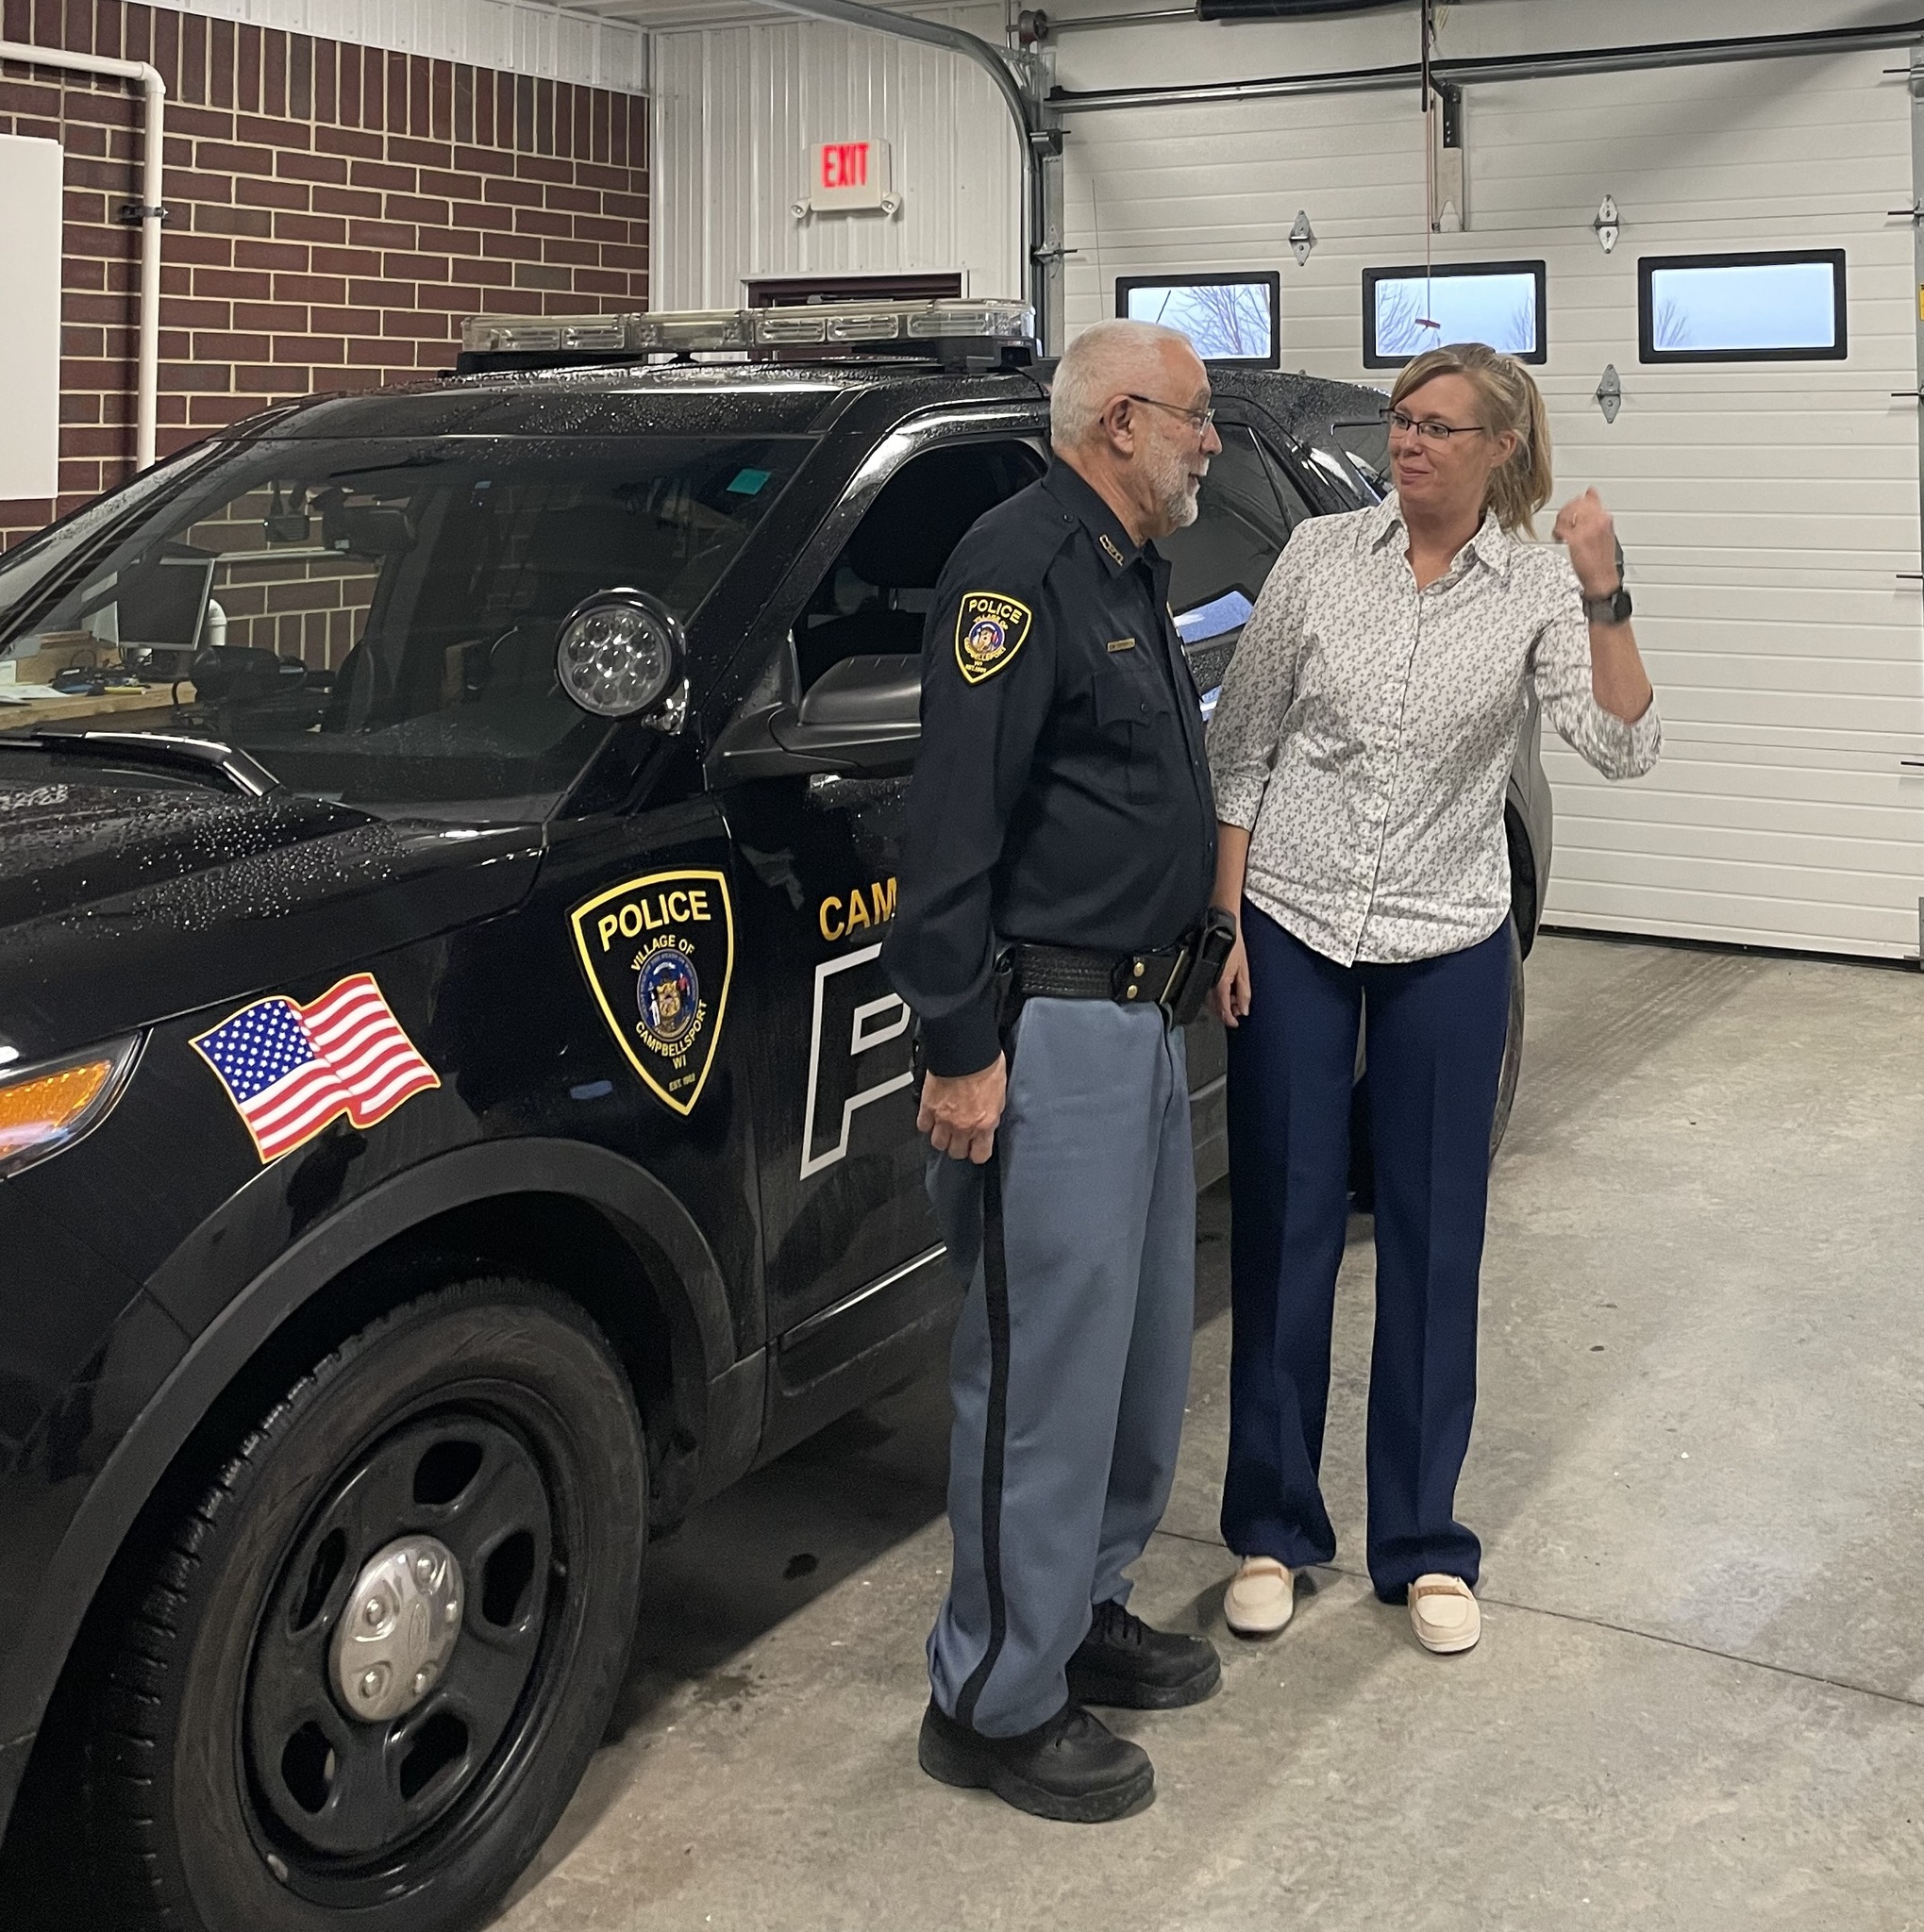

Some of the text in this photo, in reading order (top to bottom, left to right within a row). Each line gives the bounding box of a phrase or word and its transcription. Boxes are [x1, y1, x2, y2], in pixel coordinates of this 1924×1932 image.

[822, 142, 870, 189] EXIT
[968, 598, 1023, 625] POLICE
[597, 891, 711, 953] POLICE
[819, 876, 896, 941] CAM
[630, 934, 695, 972] VILLAGE OF
[635, 999, 709, 1057] CAMPBELLSPORT
[673, 1056, 687, 1070] WI
